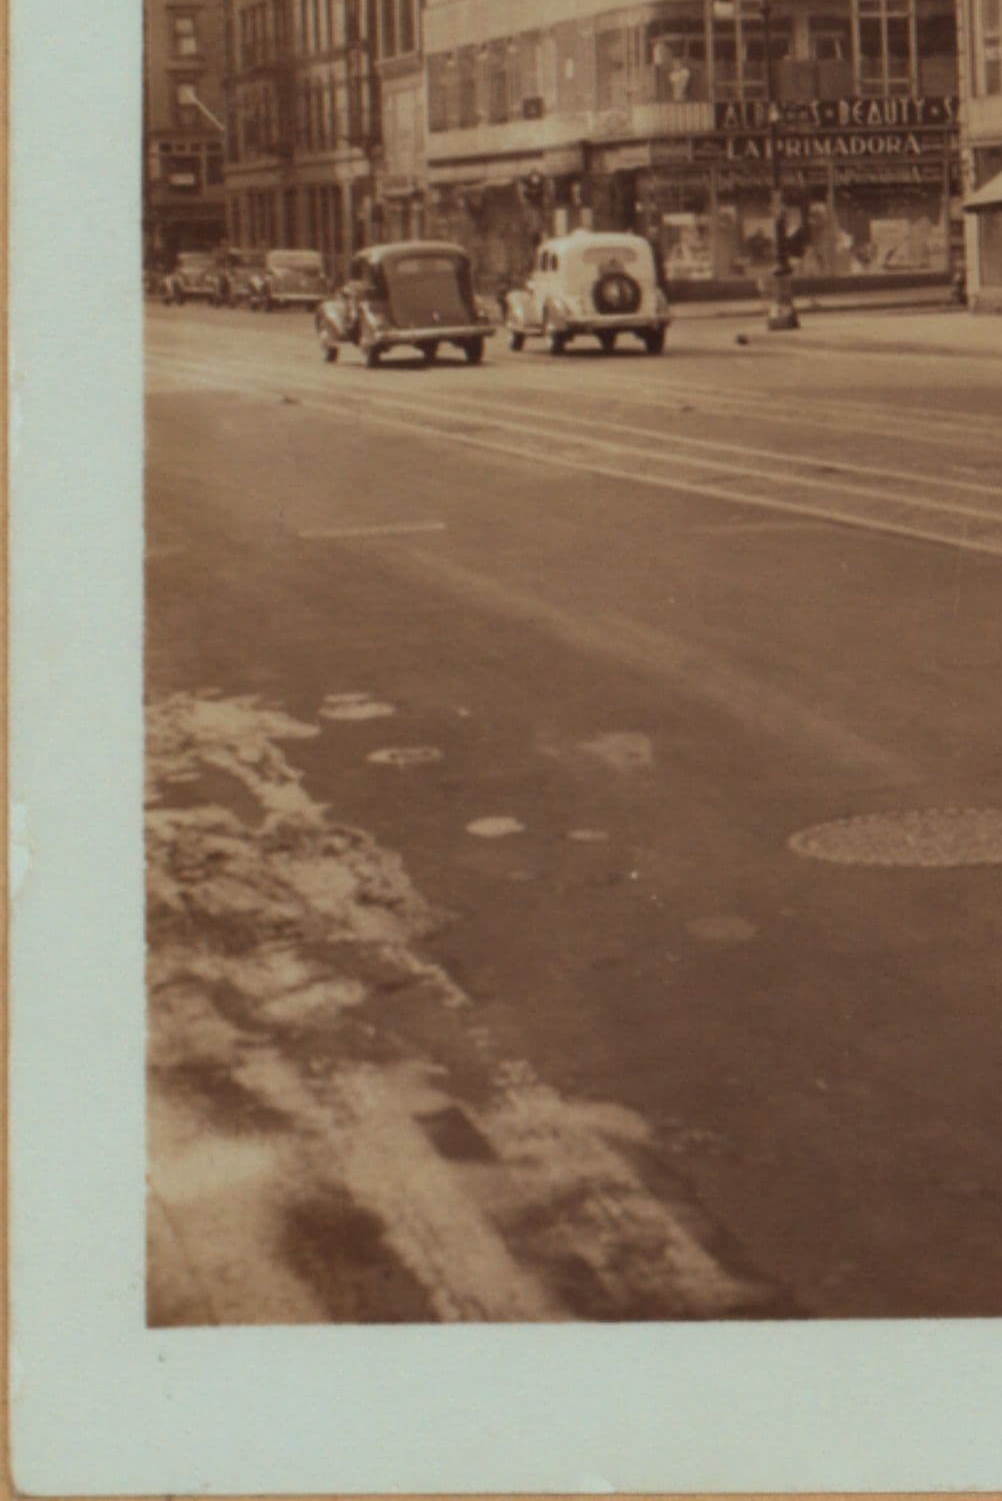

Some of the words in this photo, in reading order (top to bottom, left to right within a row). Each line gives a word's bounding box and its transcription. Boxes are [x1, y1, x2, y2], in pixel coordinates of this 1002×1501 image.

[838, 99, 926, 125] BEAUTY
[726, 135, 760, 160] LA
[764, 132, 922, 159] PRIMADORA
